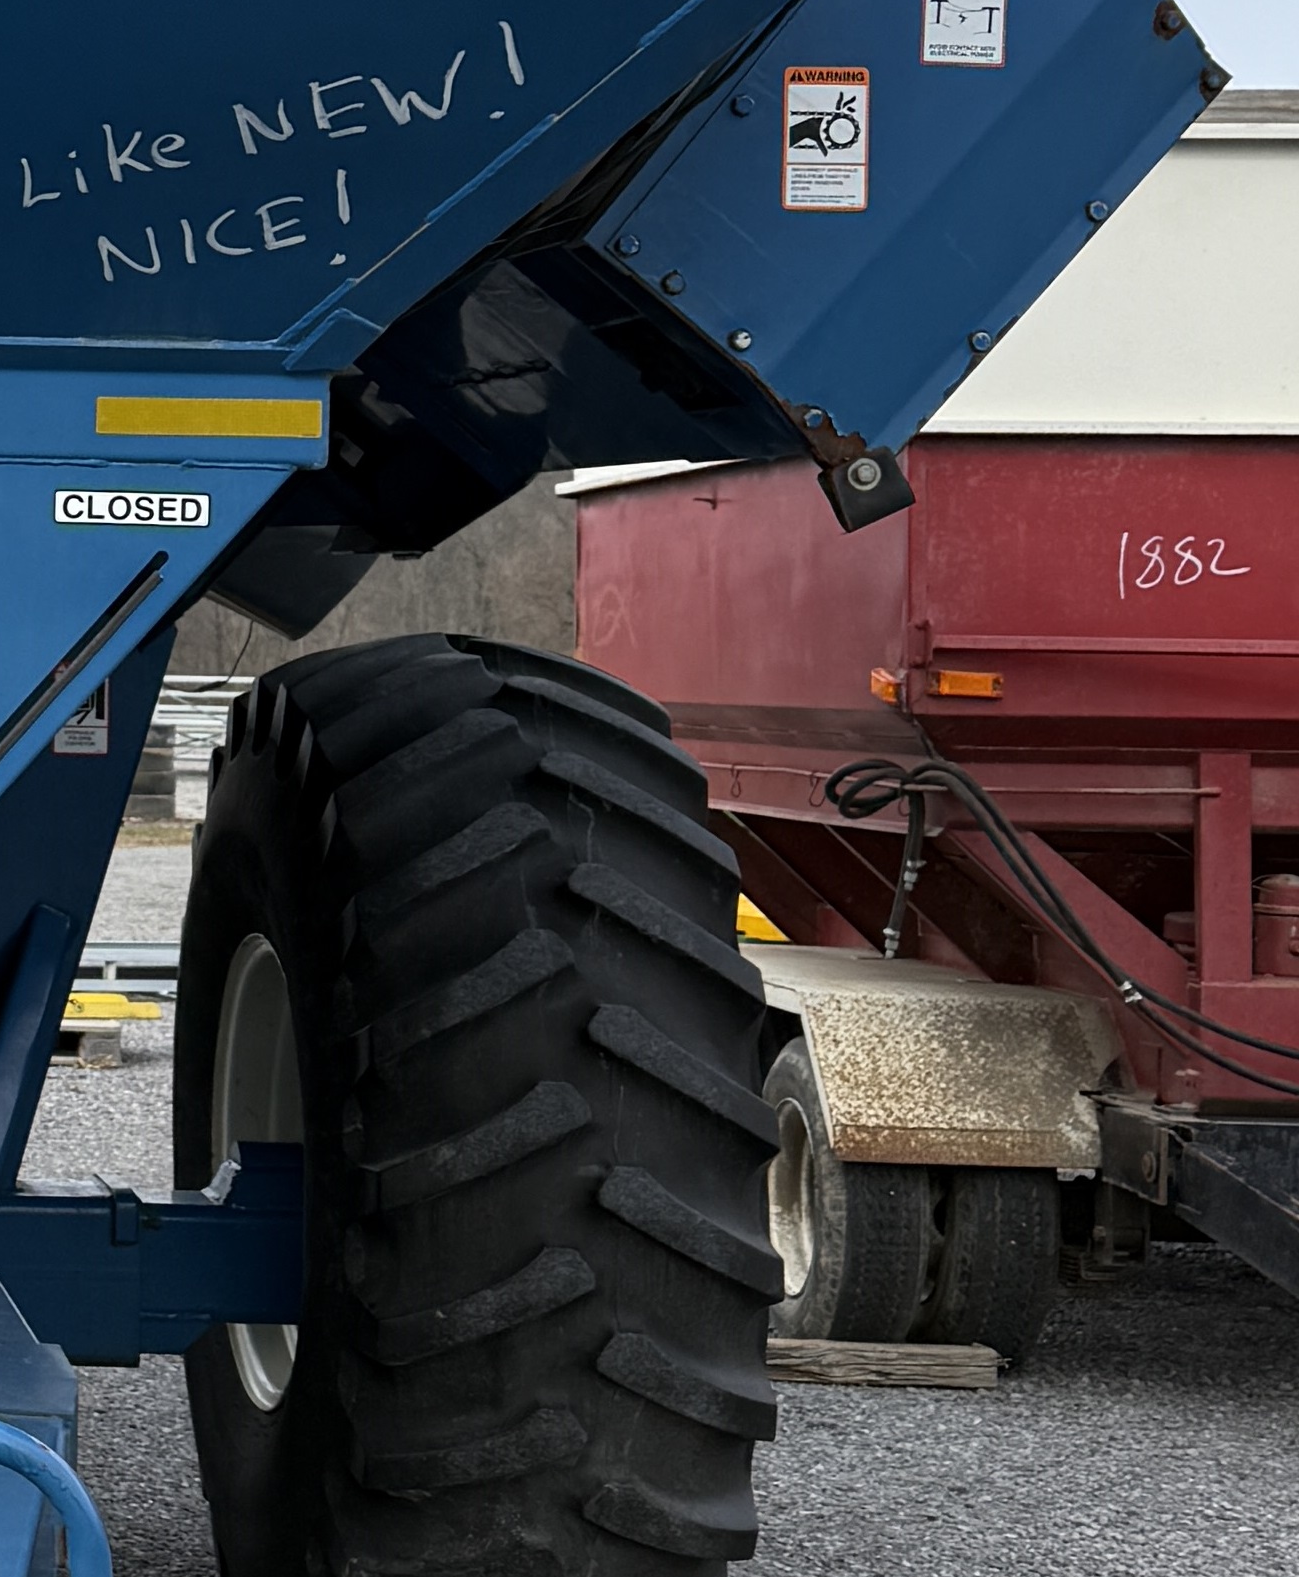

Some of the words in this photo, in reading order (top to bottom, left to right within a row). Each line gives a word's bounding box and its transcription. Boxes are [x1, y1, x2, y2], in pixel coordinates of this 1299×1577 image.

[232, 20, 525, 155] NEW!
[804, 70, 865, 83] WARNING
[98, 168, 350, 282] NICE!
[61, 494, 203, 523] CLOSED
[1118, 531, 1251, 599] 1882
